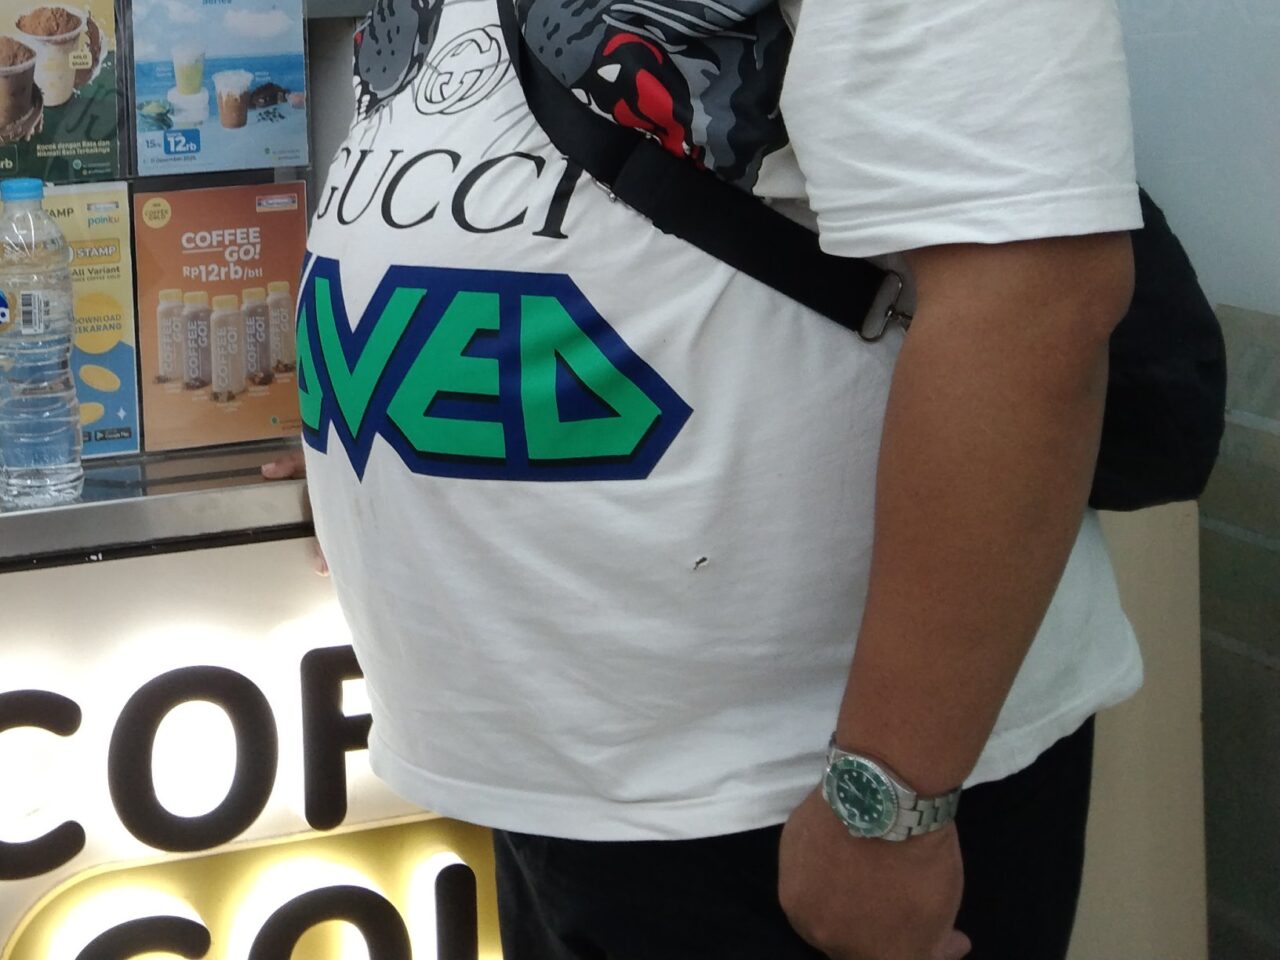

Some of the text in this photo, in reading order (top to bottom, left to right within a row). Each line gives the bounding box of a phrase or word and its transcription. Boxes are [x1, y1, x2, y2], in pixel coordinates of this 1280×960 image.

[167, 135, 198, 153] 12rb
[46, 207, 74, 220] AMP
[87, 215, 120, 229] poinku
[181, 227, 261, 249] COFFEE
[76, 245, 117, 258] STAMP
[224, 244, 261, 262] GO!
[89, 266, 121, 277] Variant
